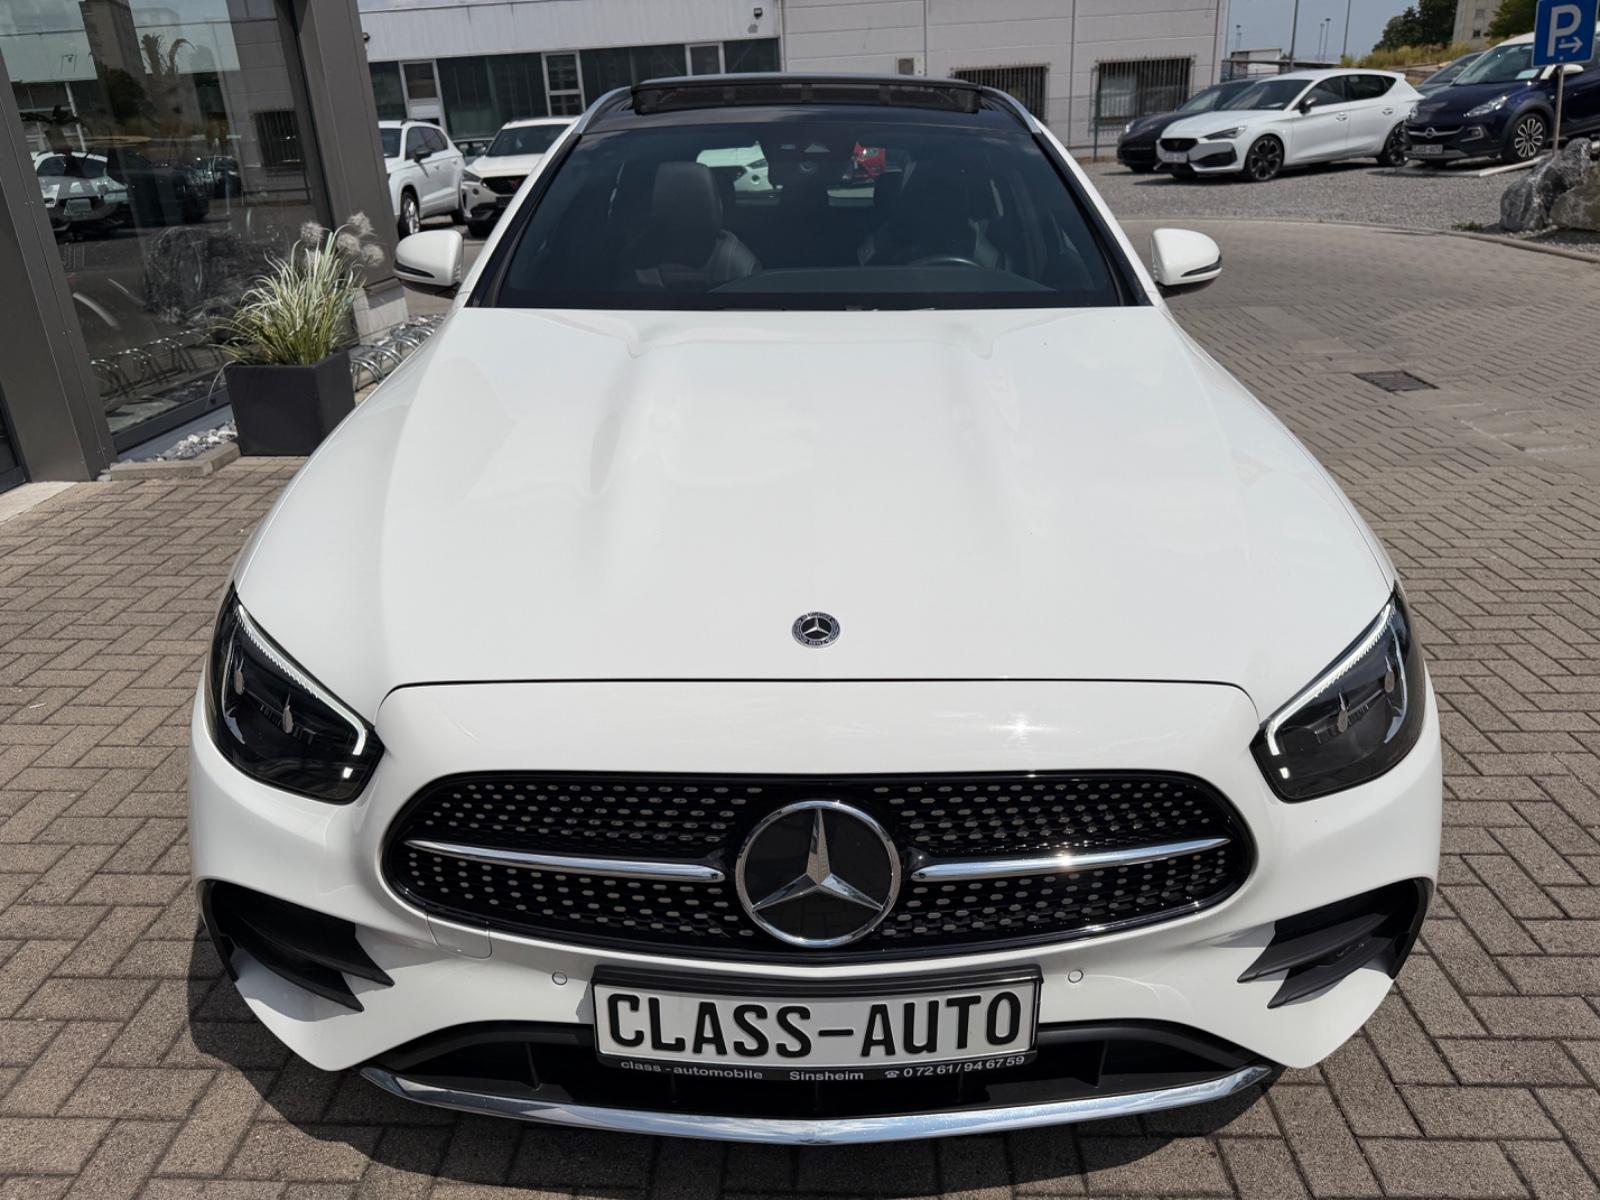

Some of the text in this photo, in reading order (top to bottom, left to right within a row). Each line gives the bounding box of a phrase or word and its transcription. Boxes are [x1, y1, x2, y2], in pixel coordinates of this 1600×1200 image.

[1547, 4, 1582, 57] P
[607, 991, 1022, 1058] CLASS-AUTO
[789, 1070, 864, 1081] Sinsheim
